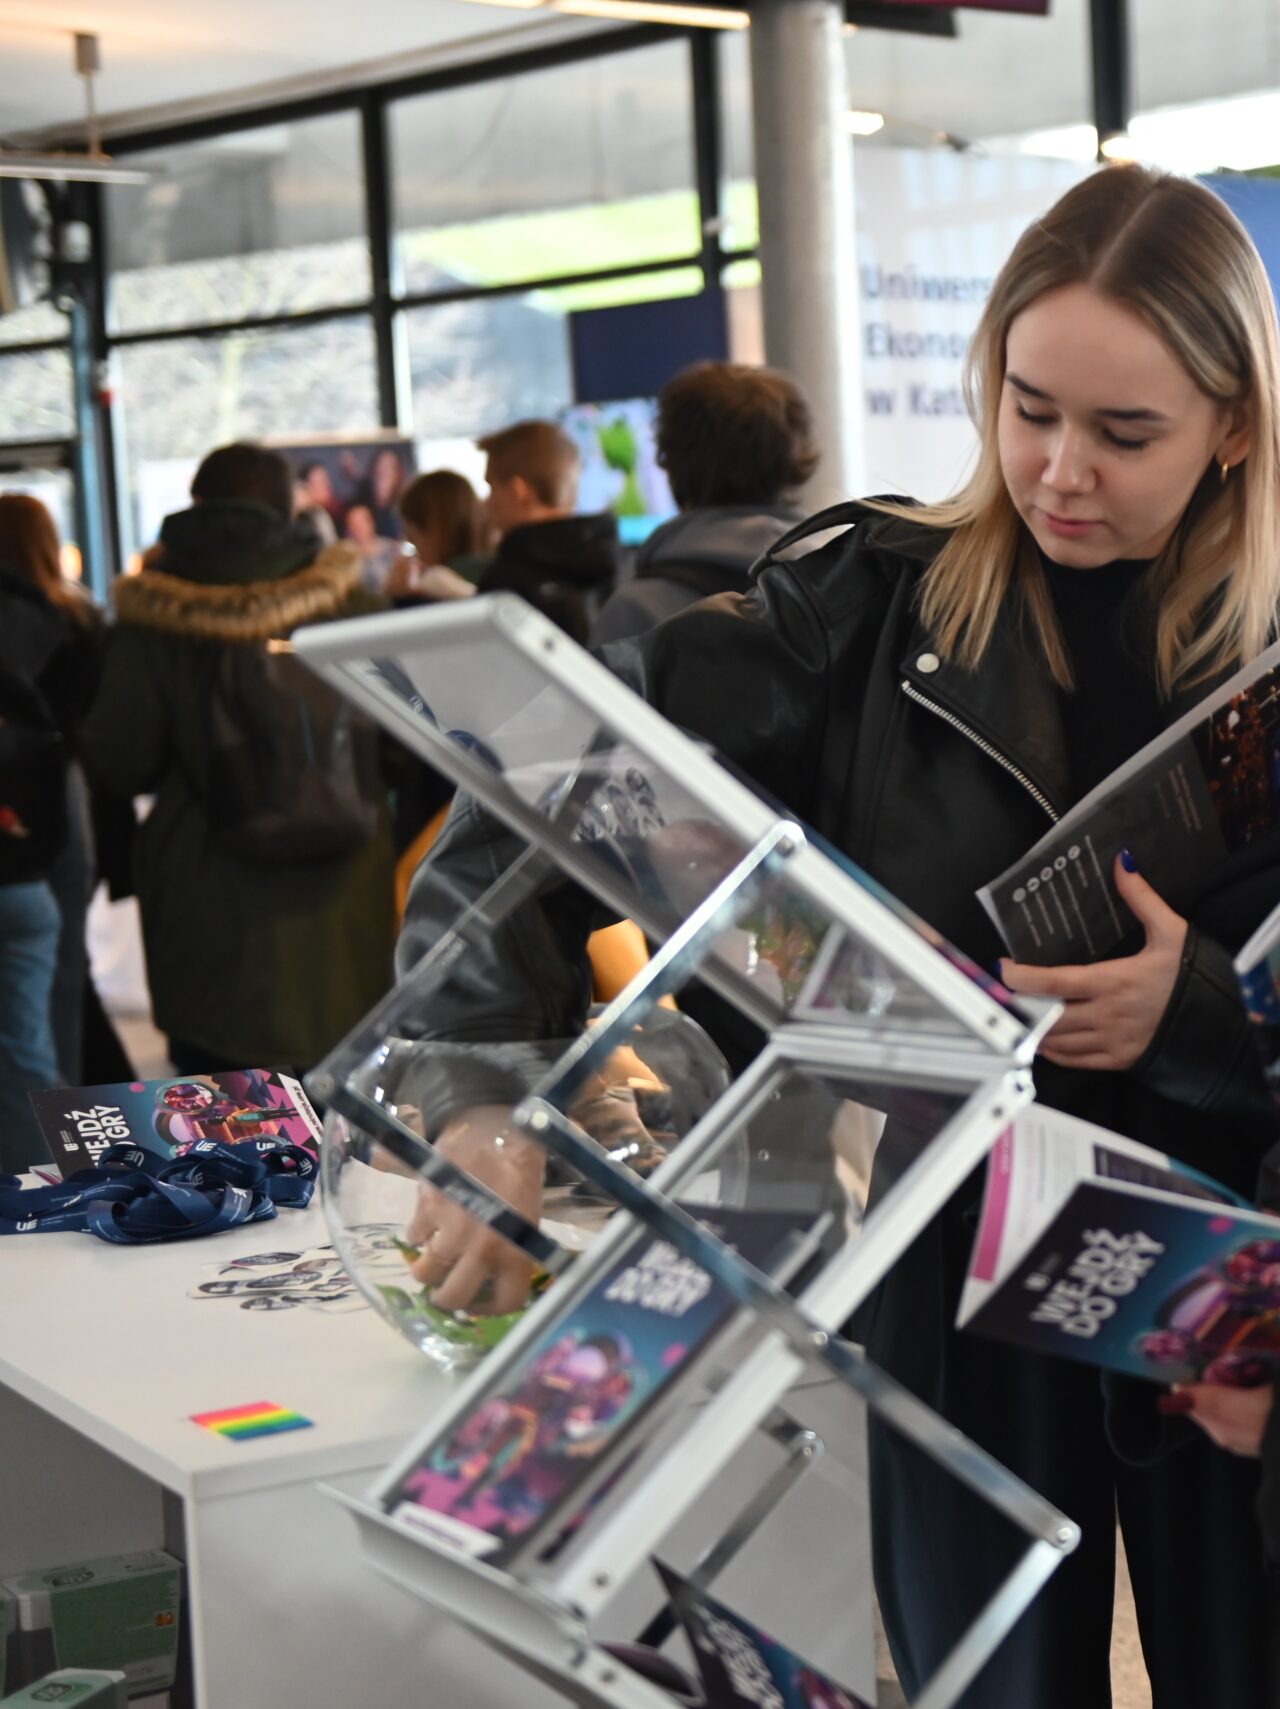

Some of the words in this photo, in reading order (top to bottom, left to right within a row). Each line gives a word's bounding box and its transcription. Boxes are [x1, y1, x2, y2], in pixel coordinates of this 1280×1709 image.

[94, 1104, 131, 1139] GRY
[195, 1140, 217, 1152] UE
[124, 1150, 145, 1168] UE
[299, 1158, 313, 1177] UE
[16, 1218, 38, 1231] UE
[1061, 1292, 1120, 1340] DO
[1102, 1230, 1167, 1302] GRY
